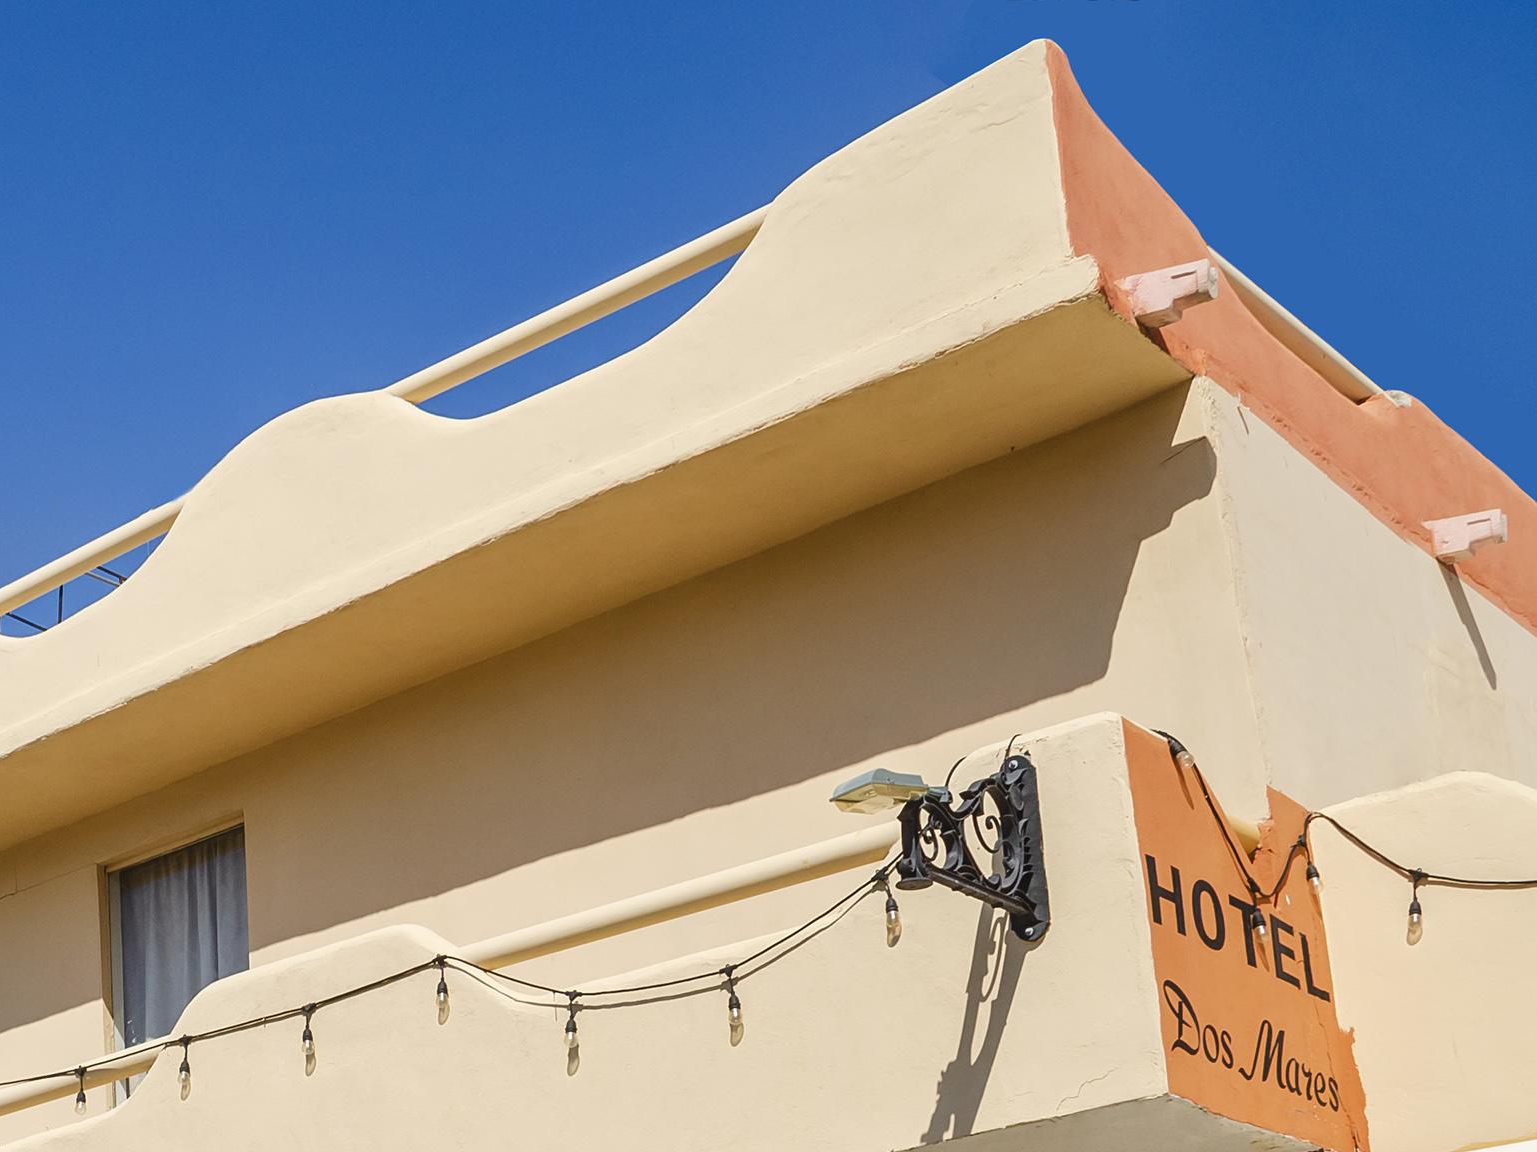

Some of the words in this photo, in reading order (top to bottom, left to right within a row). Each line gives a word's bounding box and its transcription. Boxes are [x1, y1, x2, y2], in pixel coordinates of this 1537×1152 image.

[1145, 853, 1331, 1003] HOTEL
[1163, 979, 1234, 1069] Dos
[1238, 1019, 1340, 1112] Mares
